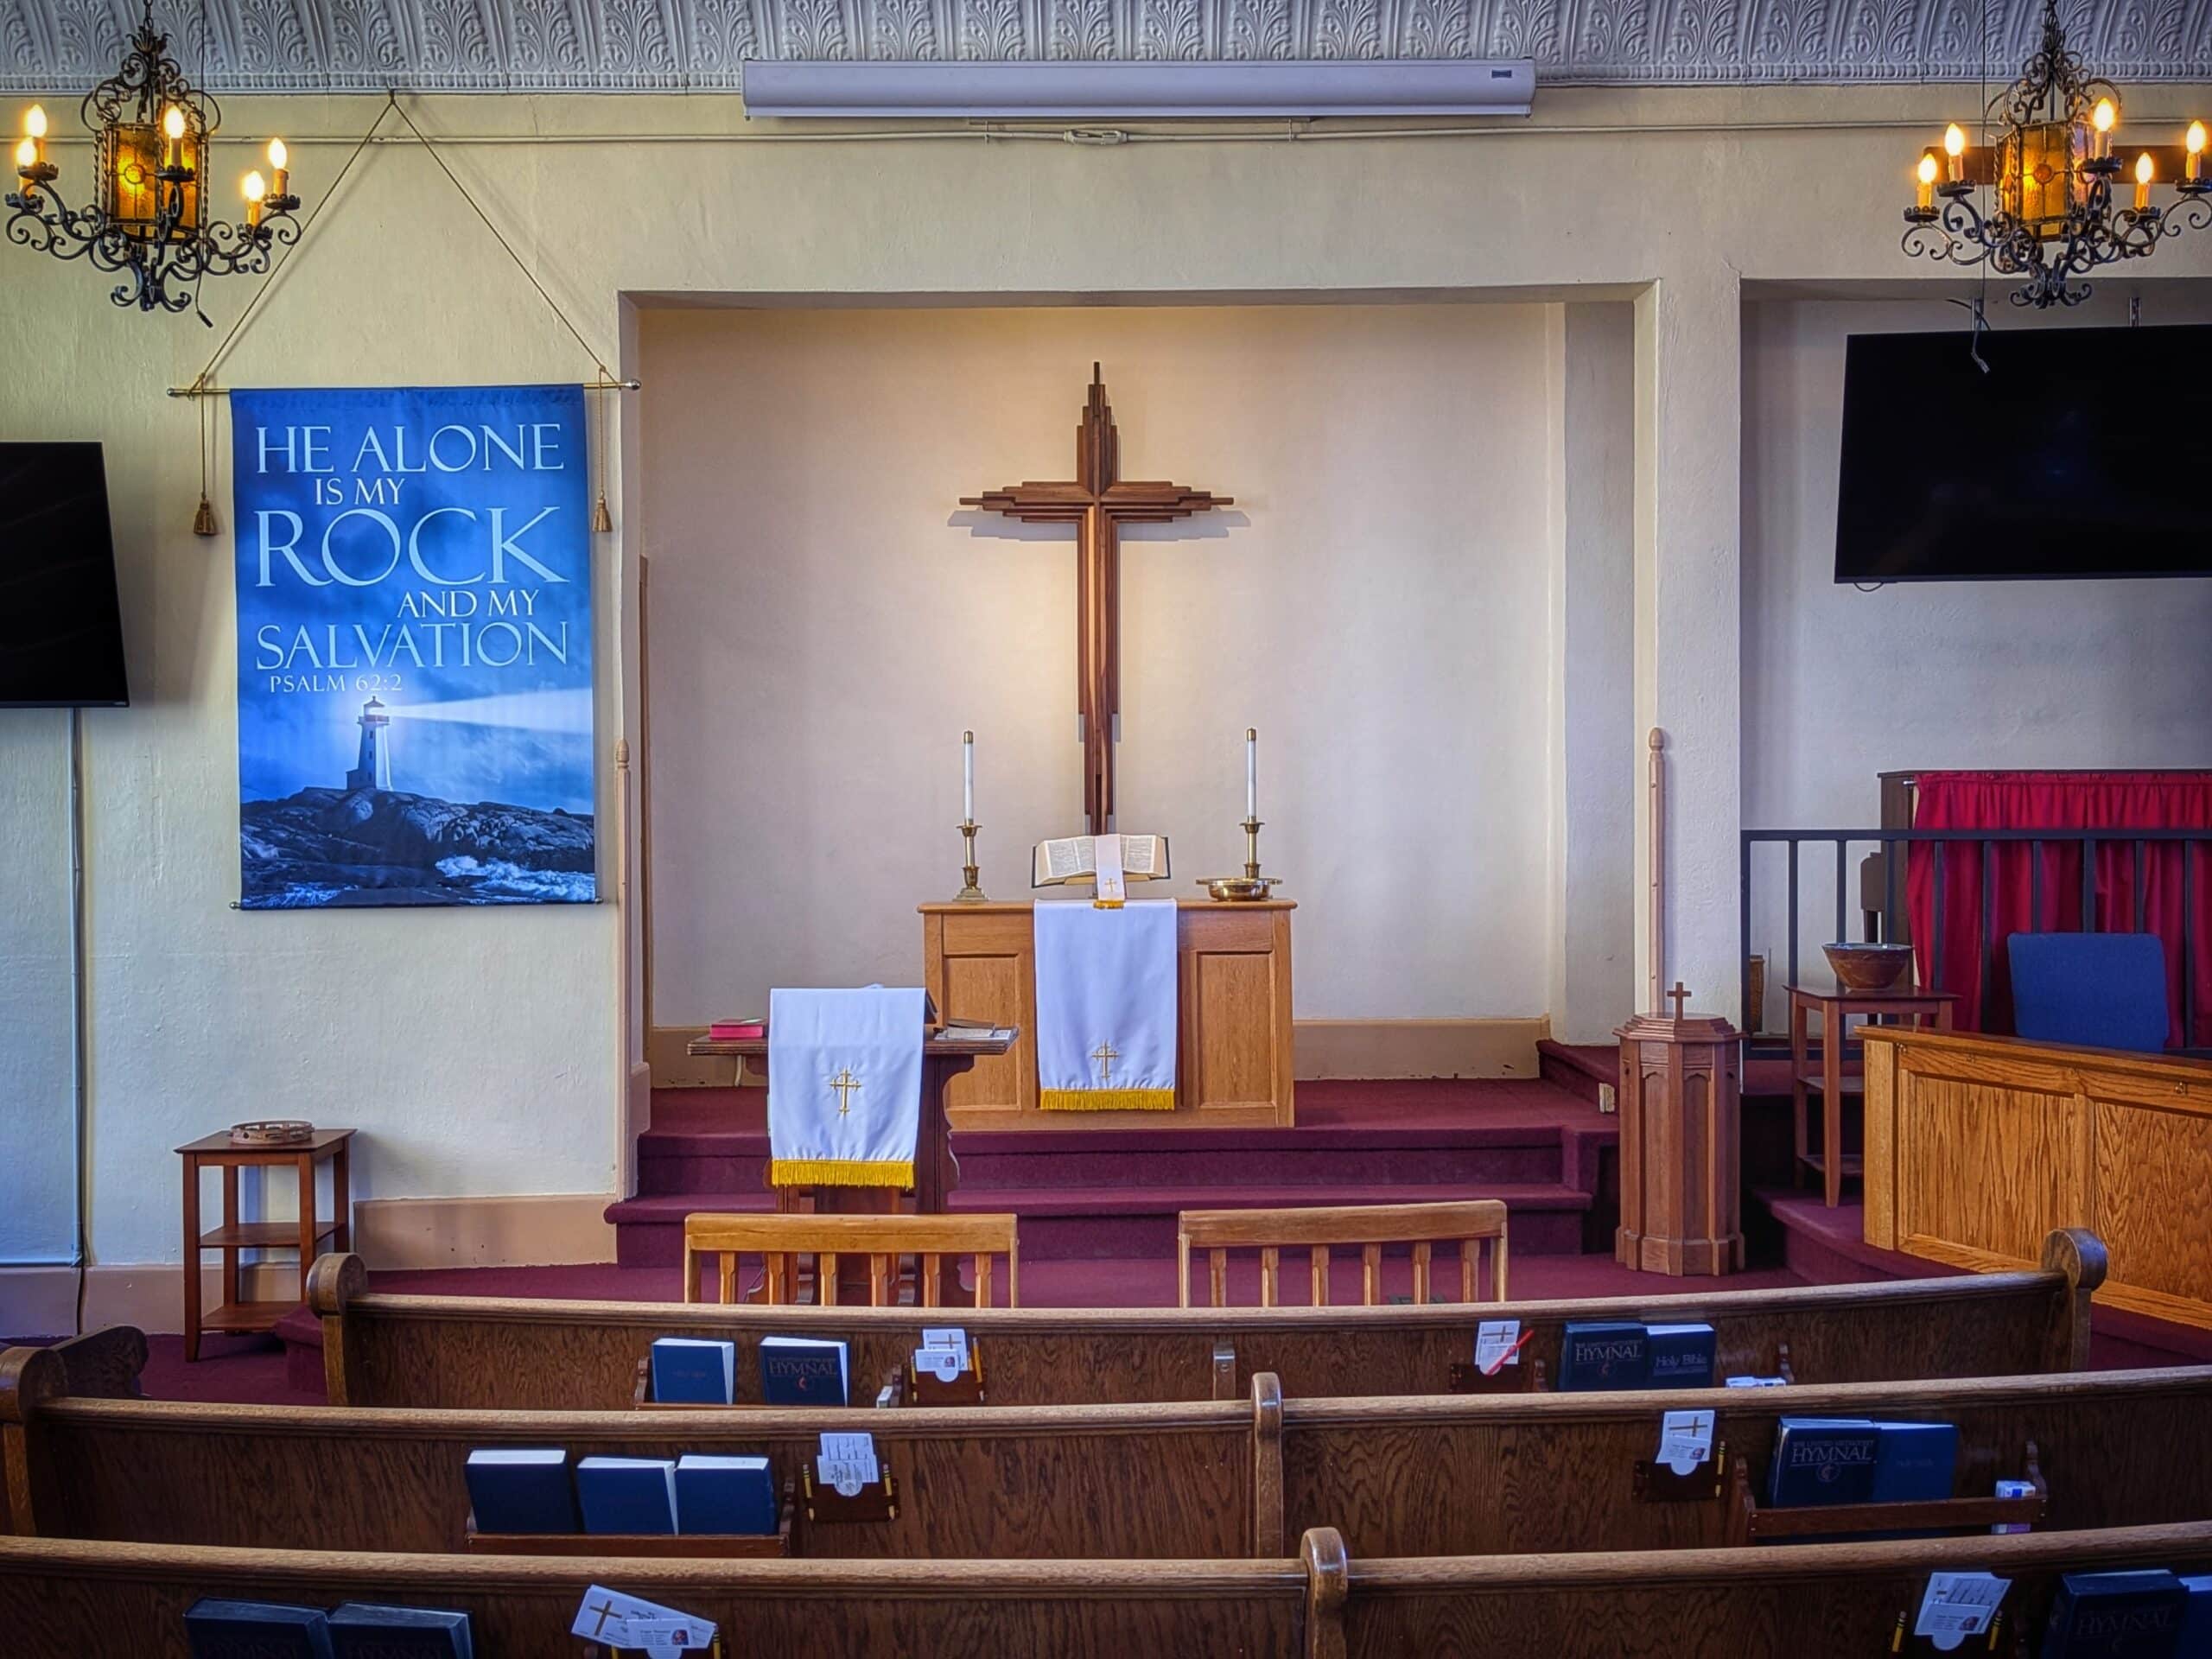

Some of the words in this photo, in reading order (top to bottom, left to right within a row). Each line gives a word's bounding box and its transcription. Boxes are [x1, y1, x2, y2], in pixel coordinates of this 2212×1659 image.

[256, 425, 334, 474] HE
[351, 423, 565, 474] ALONE
[315, 478, 343, 505] IS
[354, 478, 405, 505] MY
[254, 505, 570, 588] ROCK
[397, 590, 478, 619] AND
[487, 589, 540, 617] MY
[255, 620, 569, 671] SALVATION
[270, 675, 346, 693] PSALM
[355, 674, 403, 692] 62:2
[1574, 1344, 1643, 1363] HYMNAL
[768, 1360, 838, 1376] HYMNAL
[1790, 1445, 1873, 1464] HYMNAL
